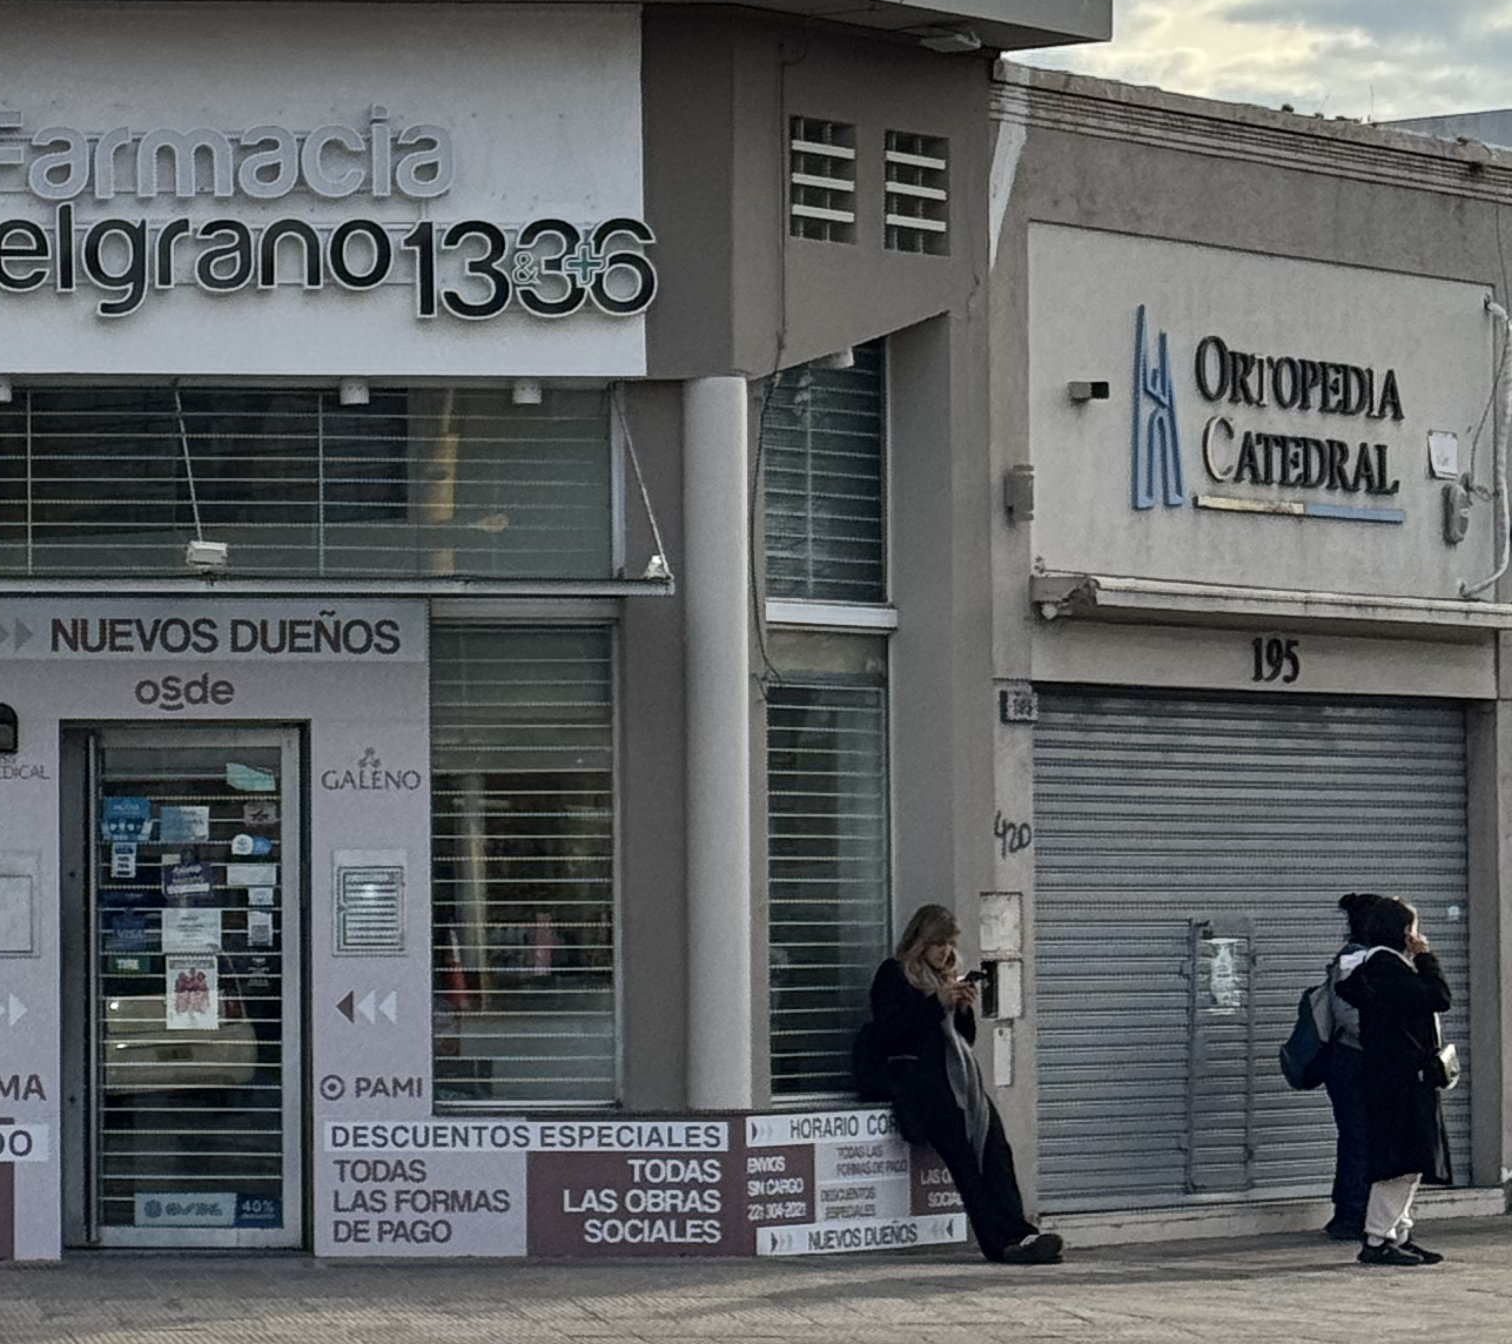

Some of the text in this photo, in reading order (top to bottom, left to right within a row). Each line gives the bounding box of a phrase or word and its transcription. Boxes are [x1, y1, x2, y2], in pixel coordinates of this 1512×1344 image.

[402, 217, 658, 320] 1336
[1194, 335, 1405, 421] ORTOPEDIA
[1202, 416, 1400, 495] CATEDRAL
[50, 609, 401, 655] NUEVOS DUEÑOS
[1251, 637, 1300, 684] 195
[135, 672, 235, 711] osde
[321, 769, 421, 791] GALENO
[994, 809, 1032, 860] 420
[355, 1076, 423, 1098] PAMI
[331, 1124, 722, 1149] DESCUENTOS ESPECIALES
[790, 1115, 859, 1139] HORARIO
[334, 1159, 428, 1184] TODAS
[627, 1158, 722, 1183] TODAS
[920, 1168, 941, 1186] LAS
[766, 1177, 805, 1195] CARGO
[242, 1198, 276, 1214] 40%
[333, 1189, 511, 1213] LAS FORMAS
[563, 1188, 722, 1213] LAS OBRAS
[333, 1219, 452, 1244] DE PAGO
[584, 1218, 722, 1244] SOCIALES
[808, 1220, 918, 1251] NUEVOS DUEÑOS
